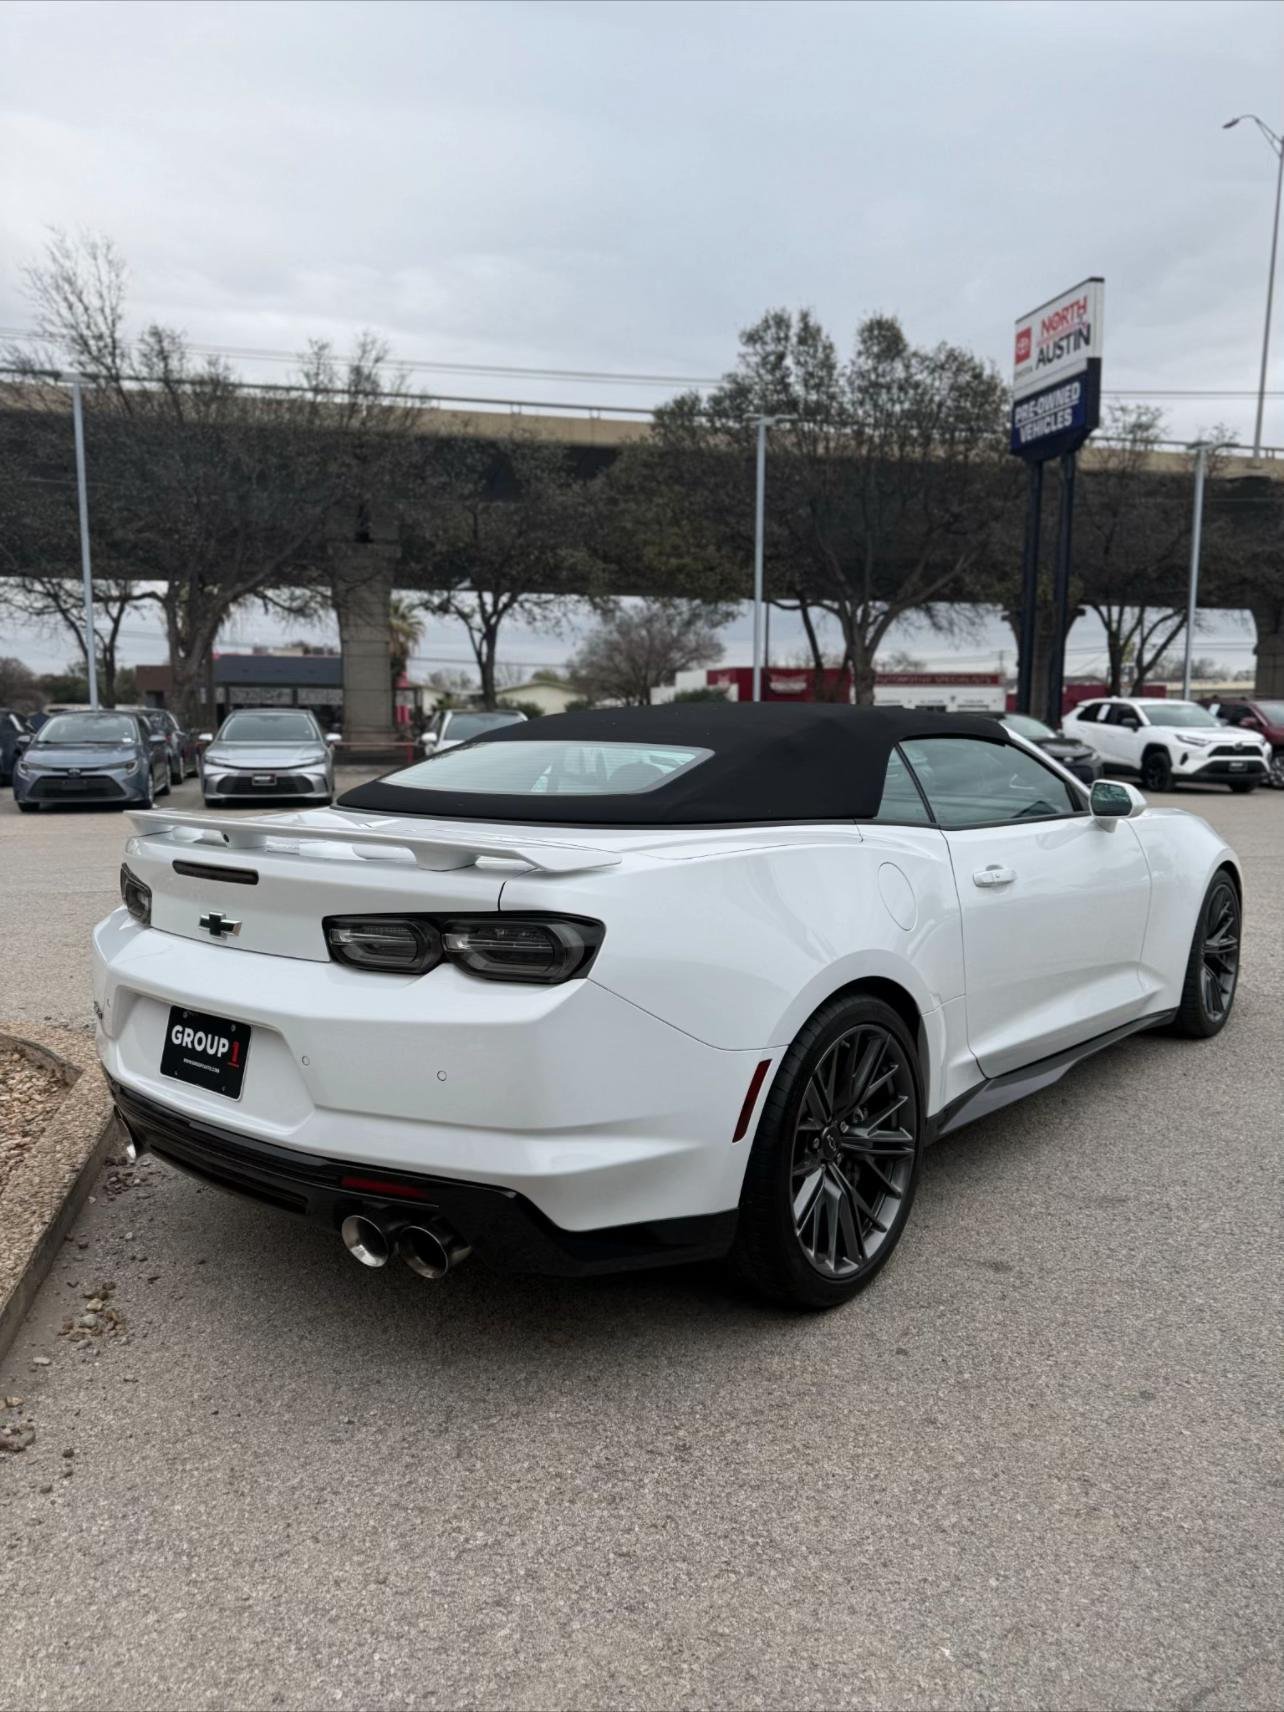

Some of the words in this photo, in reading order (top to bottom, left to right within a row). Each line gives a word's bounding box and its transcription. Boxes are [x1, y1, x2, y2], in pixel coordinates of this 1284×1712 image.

[1041, 297, 1088, 337] NORTH
[1036, 324, 1091, 370] AUSTIN
[1015, 381, 1080, 424] PRE-OWNED
[1019, 408, 1073, 443] VEHICLES
[171, 1024, 229, 1057] GROUP
